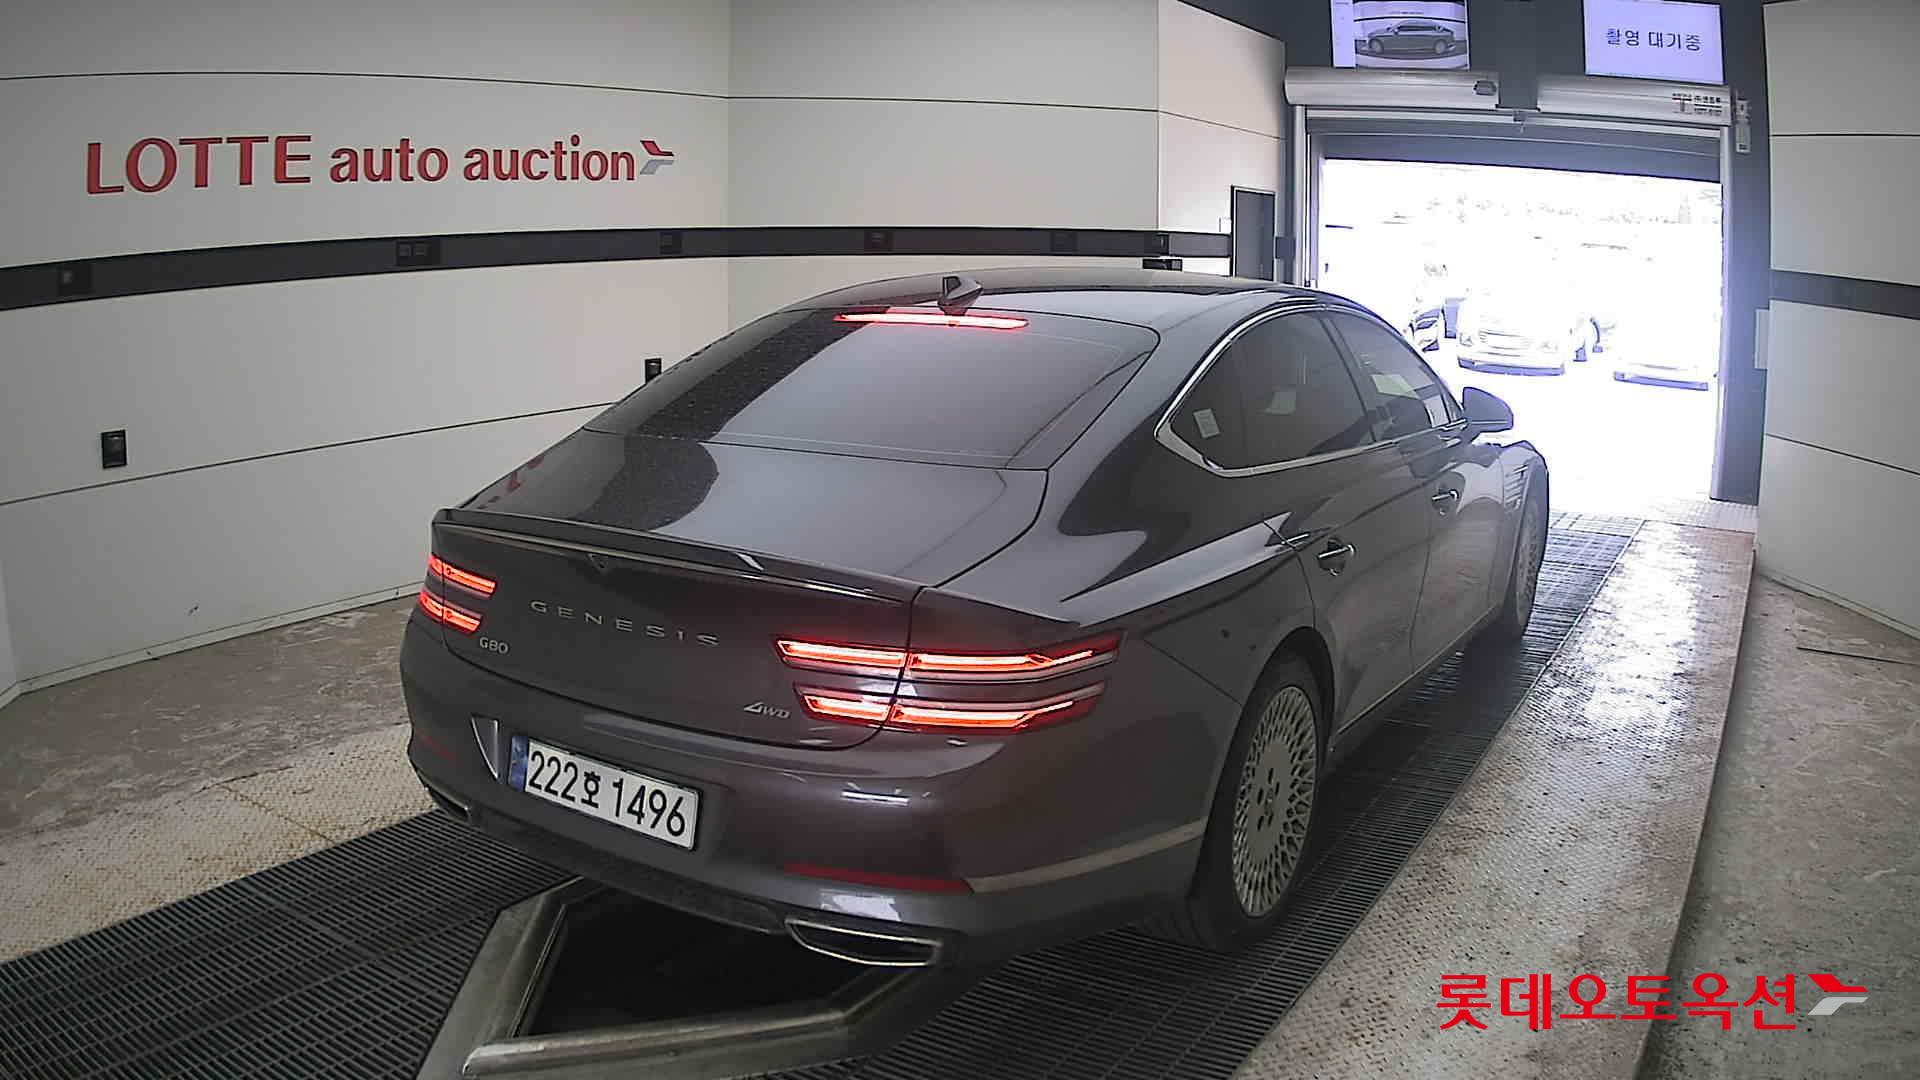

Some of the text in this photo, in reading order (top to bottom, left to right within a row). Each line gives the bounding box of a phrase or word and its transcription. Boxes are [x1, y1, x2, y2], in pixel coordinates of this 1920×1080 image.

[1647, 31, 1701, 52] 대기중
[86, 134, 636, 195] LOTTE auto auction
[479, 636, 510, 655] G80
[530, 600, 720, 647] GENESIS
[528, 750, 686, 837] 222호 1496
